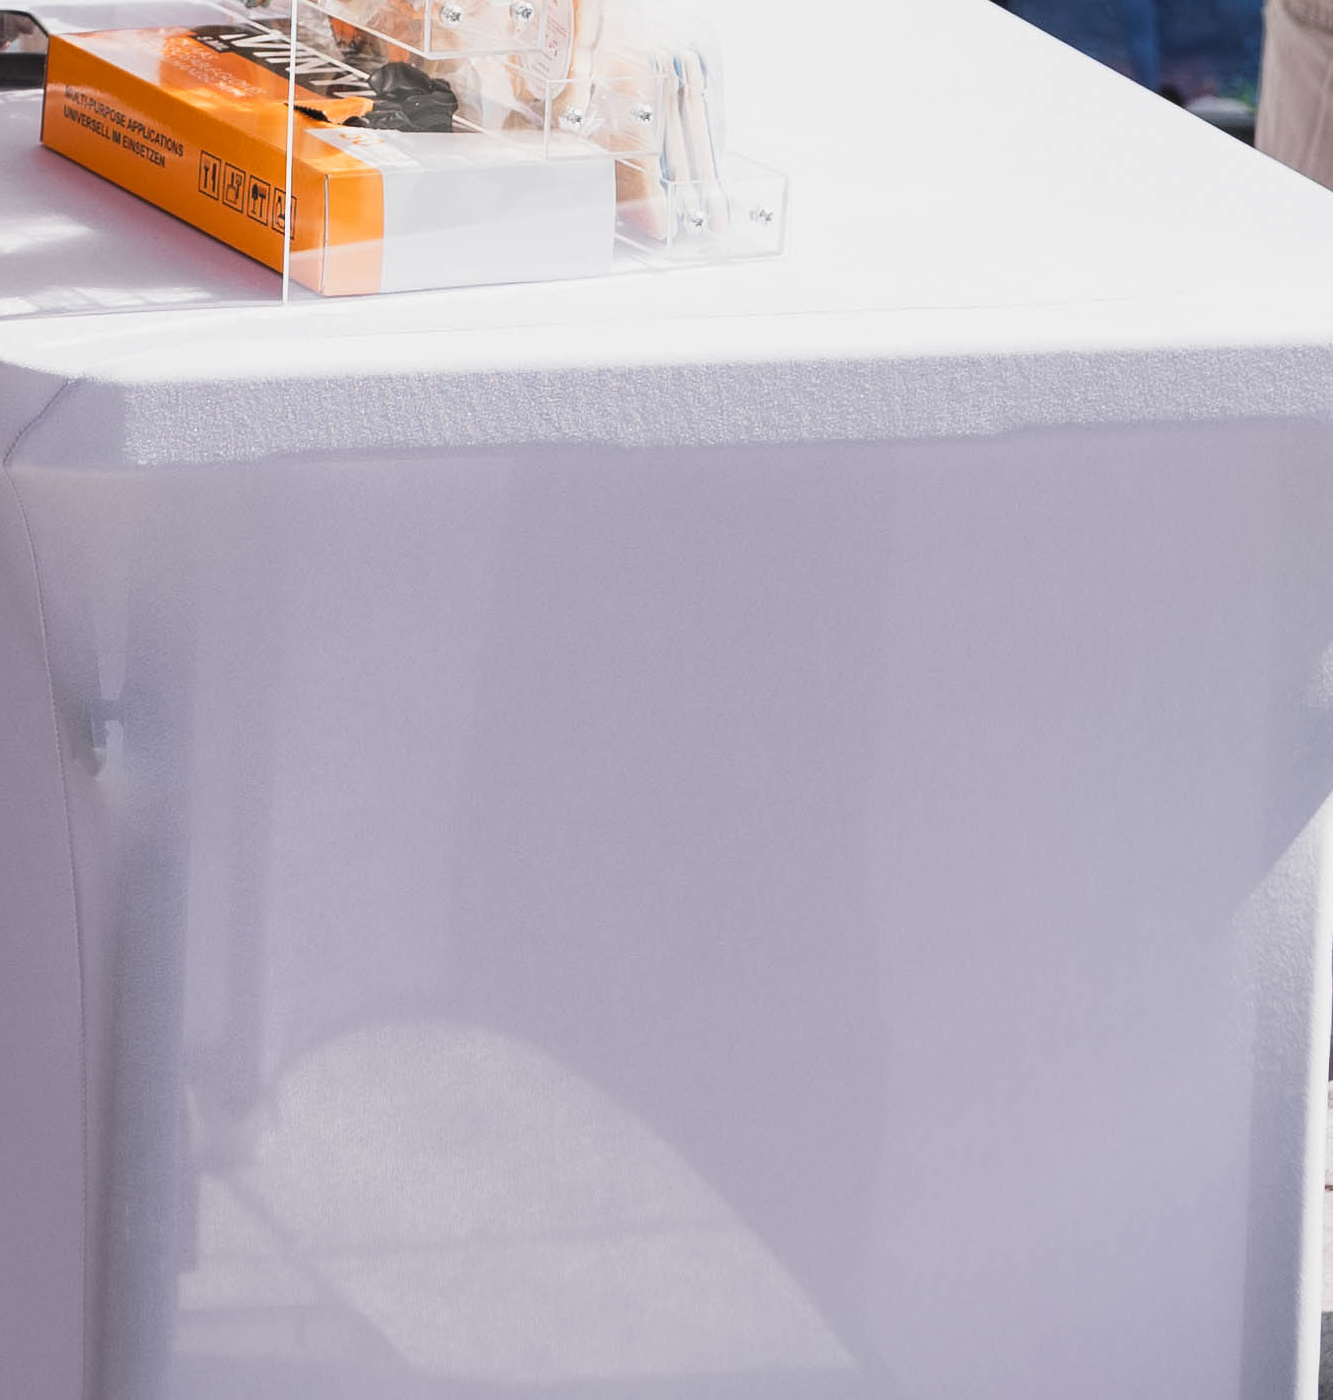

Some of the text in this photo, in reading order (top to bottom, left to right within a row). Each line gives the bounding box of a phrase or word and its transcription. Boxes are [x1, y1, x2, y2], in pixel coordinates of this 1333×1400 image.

[63, 104, 111, 140] UNIVERSELL
[122, 135, 166, 168] EINSETZEN
[65, 85, 183, 157] MULTI-PURPOSE APPLICATIONS
